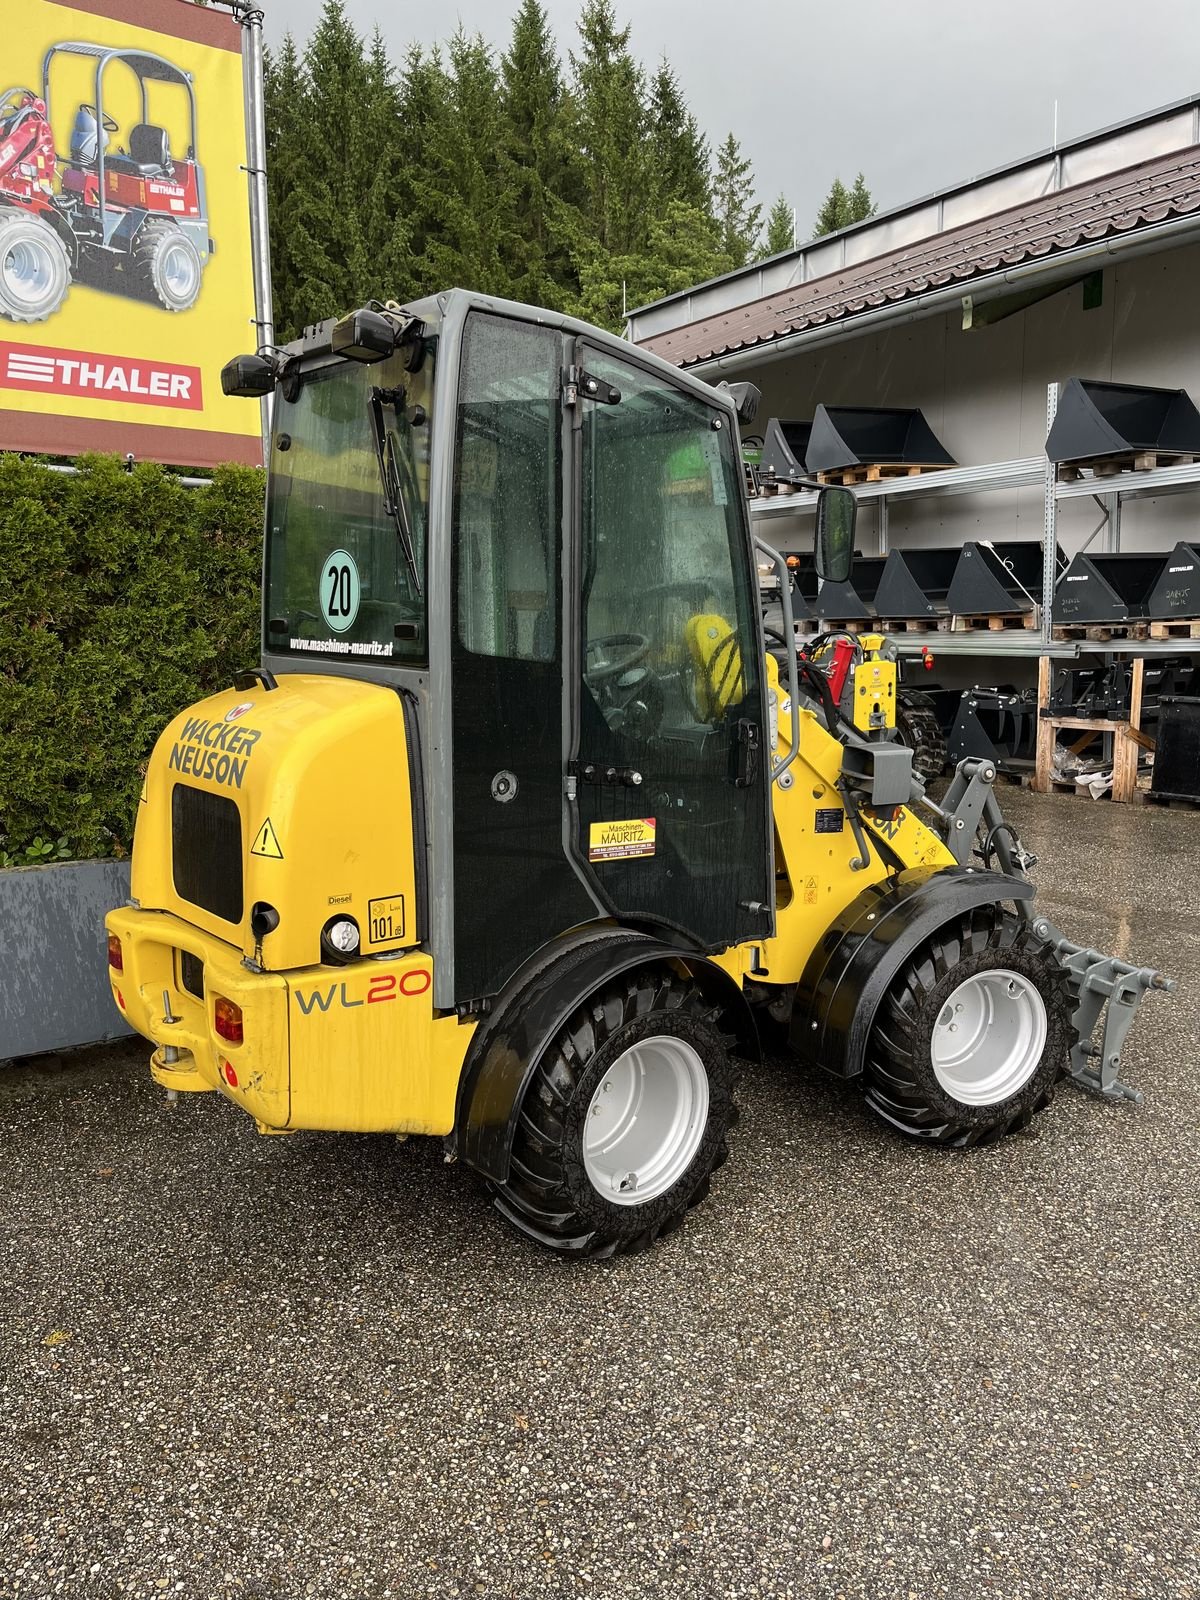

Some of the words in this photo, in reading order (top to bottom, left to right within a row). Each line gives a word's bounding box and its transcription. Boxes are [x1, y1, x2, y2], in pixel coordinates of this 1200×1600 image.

[56, 359, 192, 400] THALER
[328, 565, 351, 617] 20
[290, 638, 394, 657] www.maschinen-mauritz.at
[180, 717, 262, 757] WACKER
[169, 742, 248, 789] NEUSON
[601, 830, 644, 845] MAURITZ
[608, 823, 644, 833] Maschinen-
[329, 895, 352, 905] Diesel
[373, 916, 393, 940] 101
[294, 969, 432, 1015] WL20
